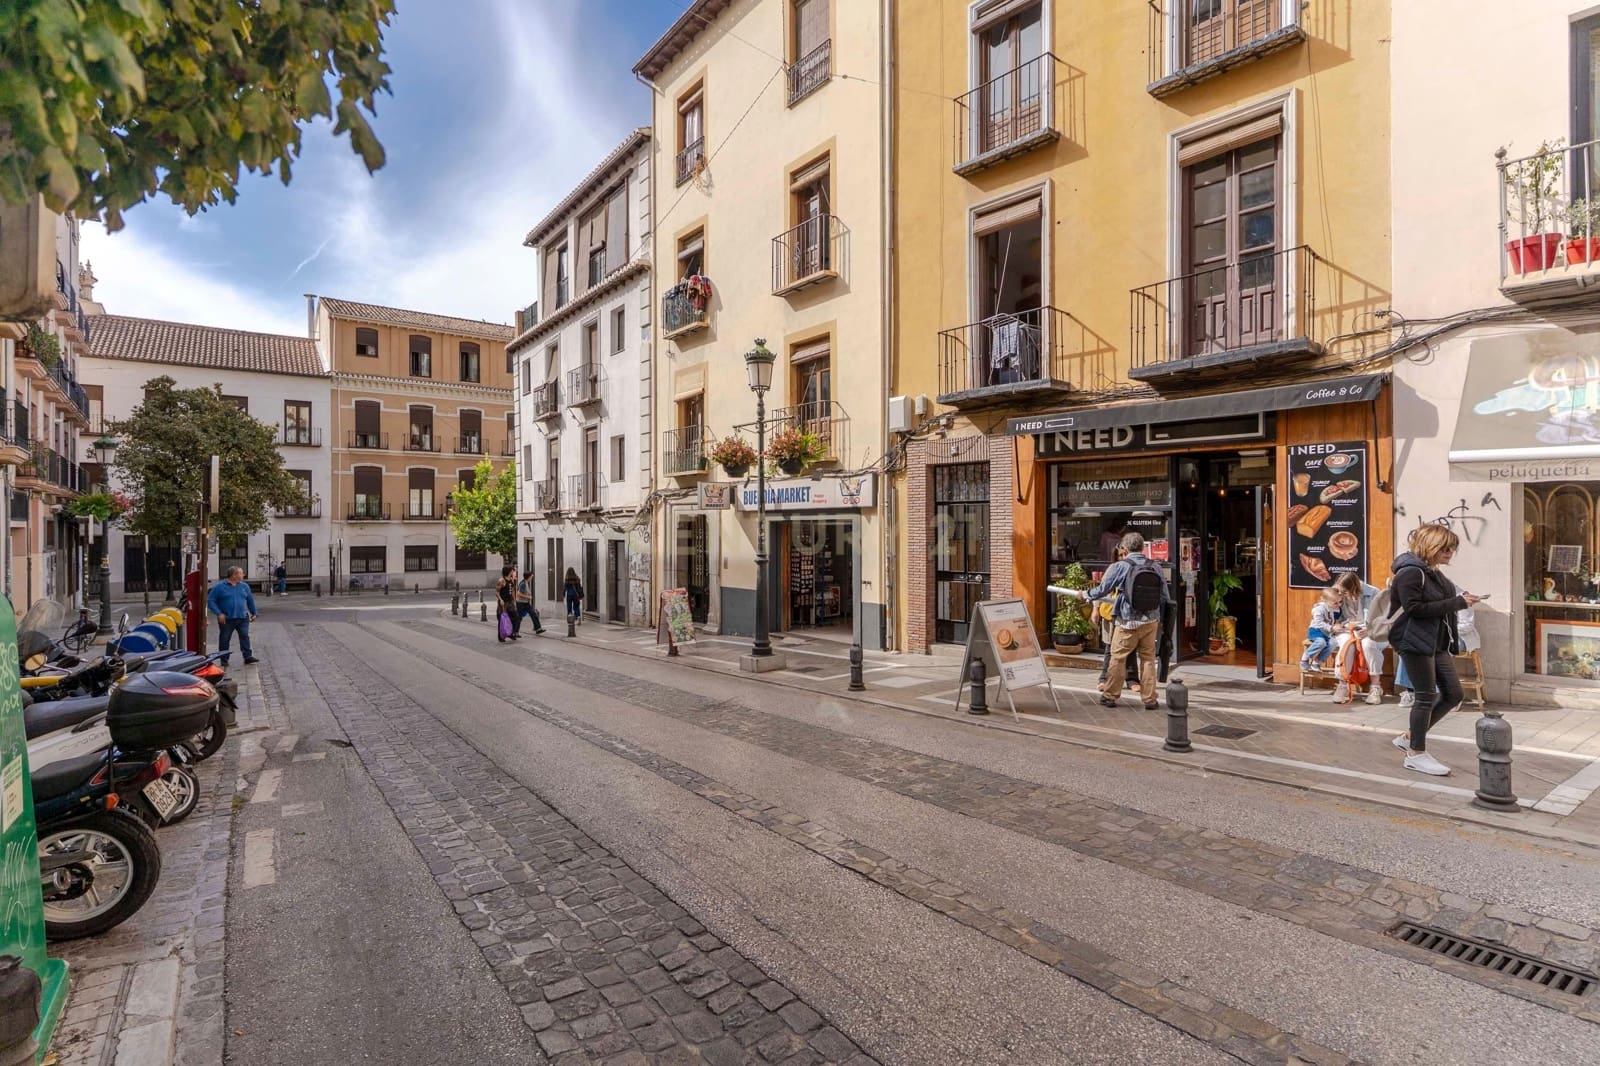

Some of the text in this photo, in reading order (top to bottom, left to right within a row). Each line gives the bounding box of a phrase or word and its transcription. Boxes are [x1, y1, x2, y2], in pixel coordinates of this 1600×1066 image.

[1306, 385, 1363, 399] Coffee & Co
[1020, 421, 1043, 430] NEED
[1054, 424, 1134, 452] NEED
[1290, 444, 1336, 456] I NEED
[1075, 480, 1131, 491] TAKE AWAY
[777, 486, 811, 504] MARKET
